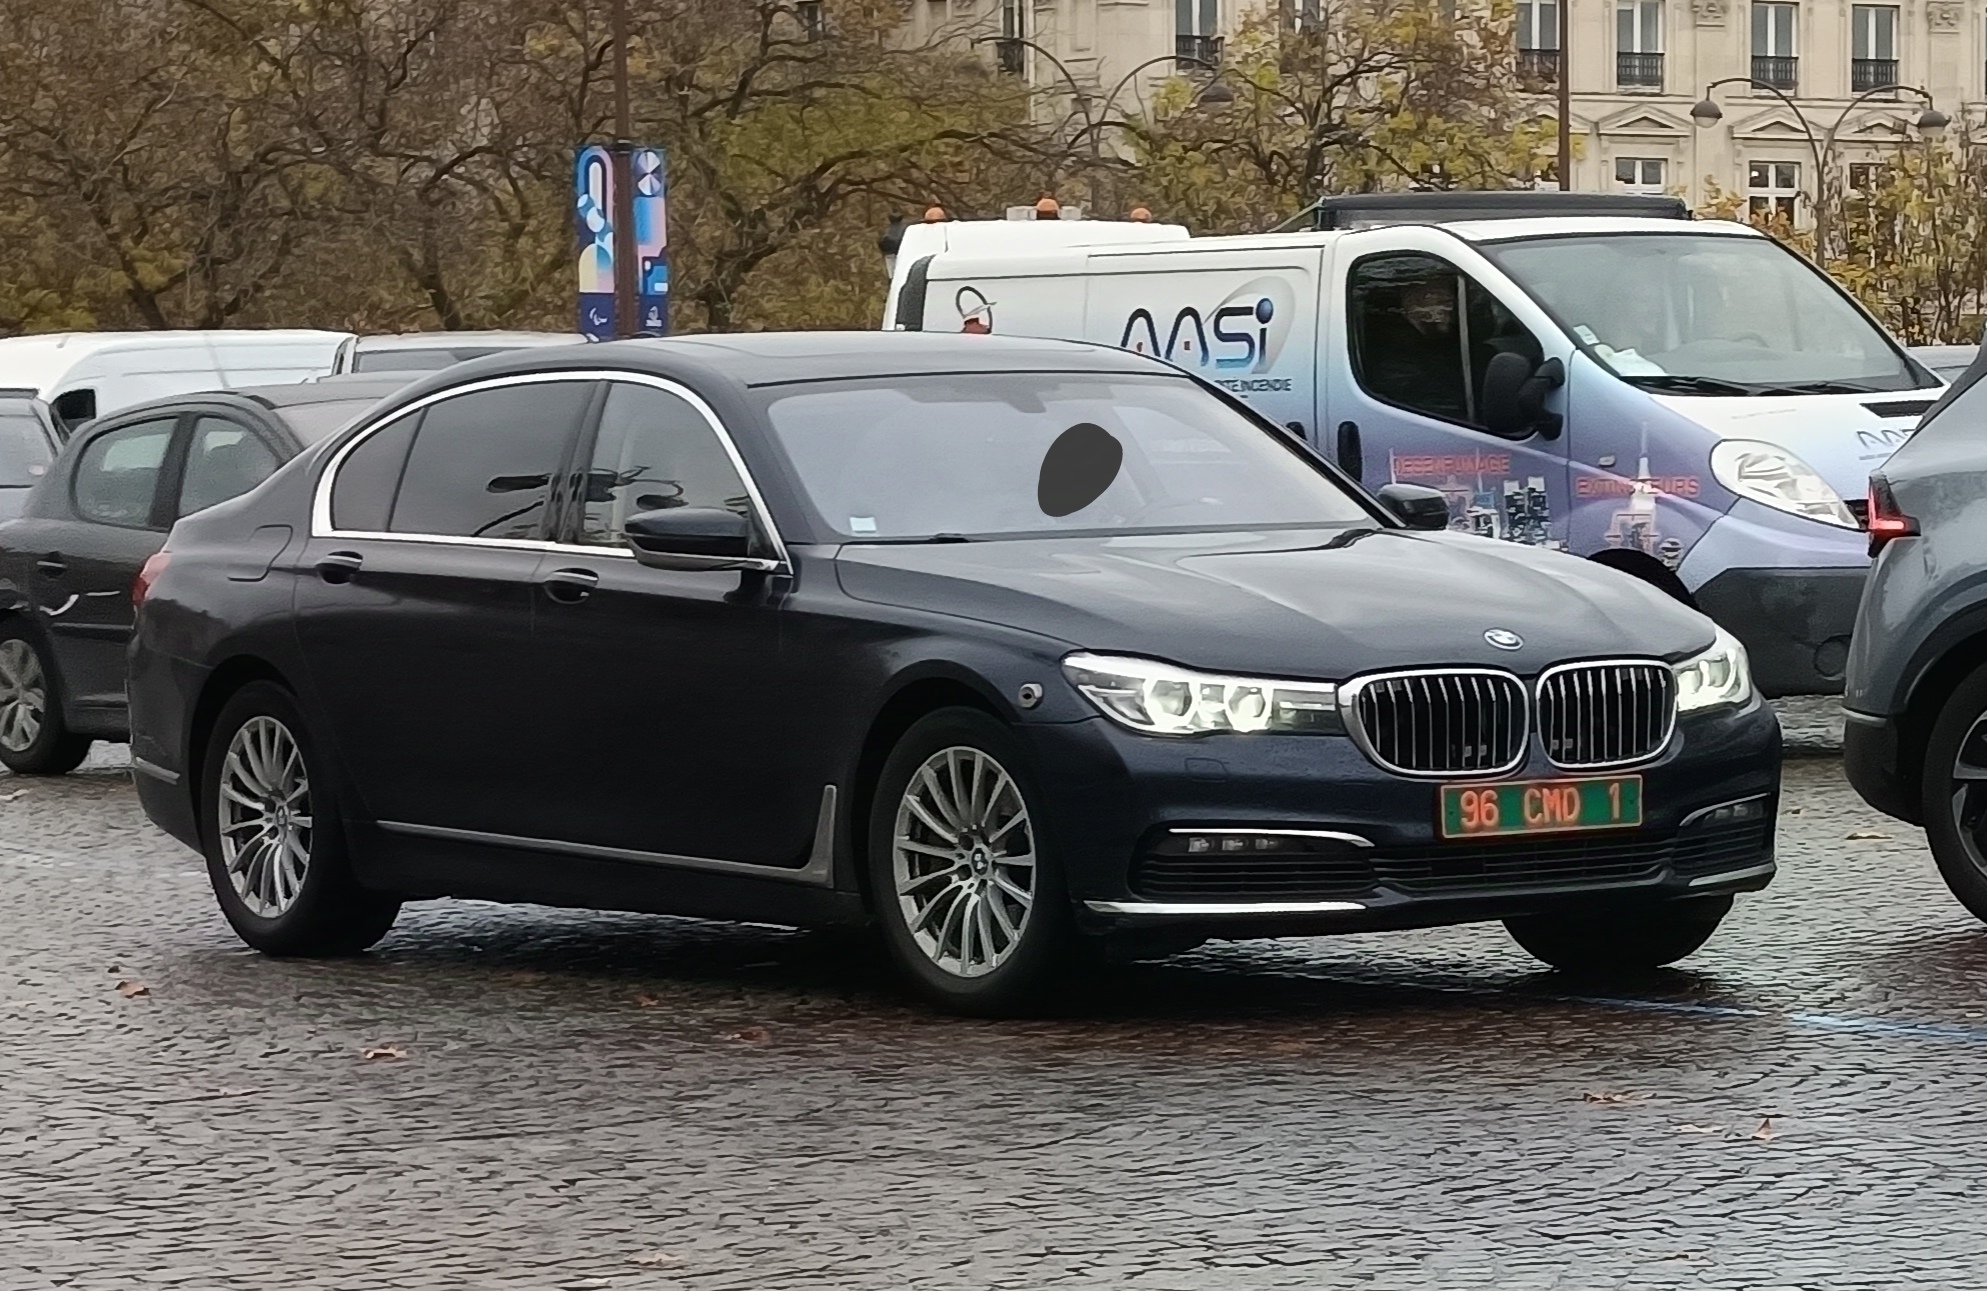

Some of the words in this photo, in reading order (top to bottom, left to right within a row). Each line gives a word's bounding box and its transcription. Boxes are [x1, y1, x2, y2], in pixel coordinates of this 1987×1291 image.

[1576, 476, 1699, 497] EXTINEURS
[1460, 789, 1499, 829] 96
[1523, 787, 1581, 824] CMD
[1609, 782, 1620, 820] 1
